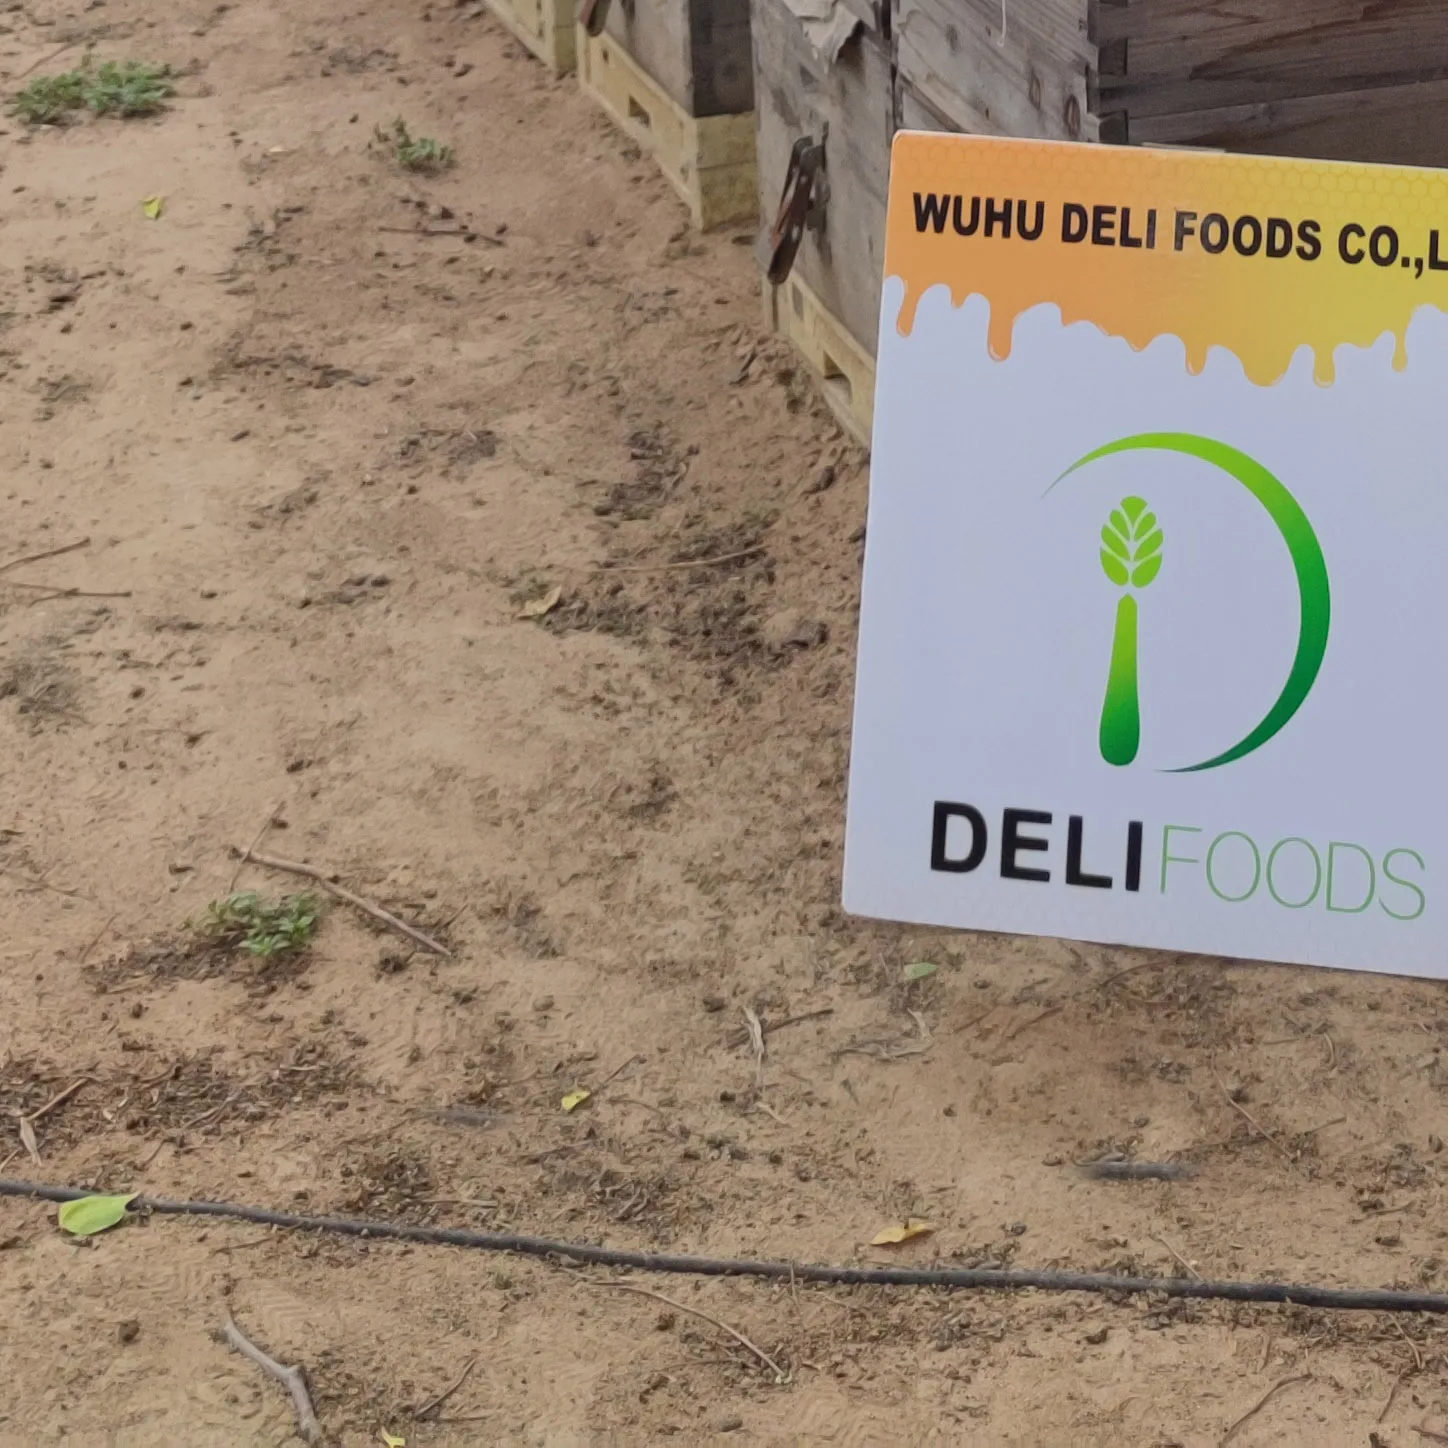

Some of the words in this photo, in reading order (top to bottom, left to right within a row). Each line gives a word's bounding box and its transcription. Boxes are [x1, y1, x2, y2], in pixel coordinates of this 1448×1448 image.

[911, 191, 1046, 242] WUHU
[1060, 201, 1158, 250] DELI
[1172, 210, 1323, 262] FOODS
